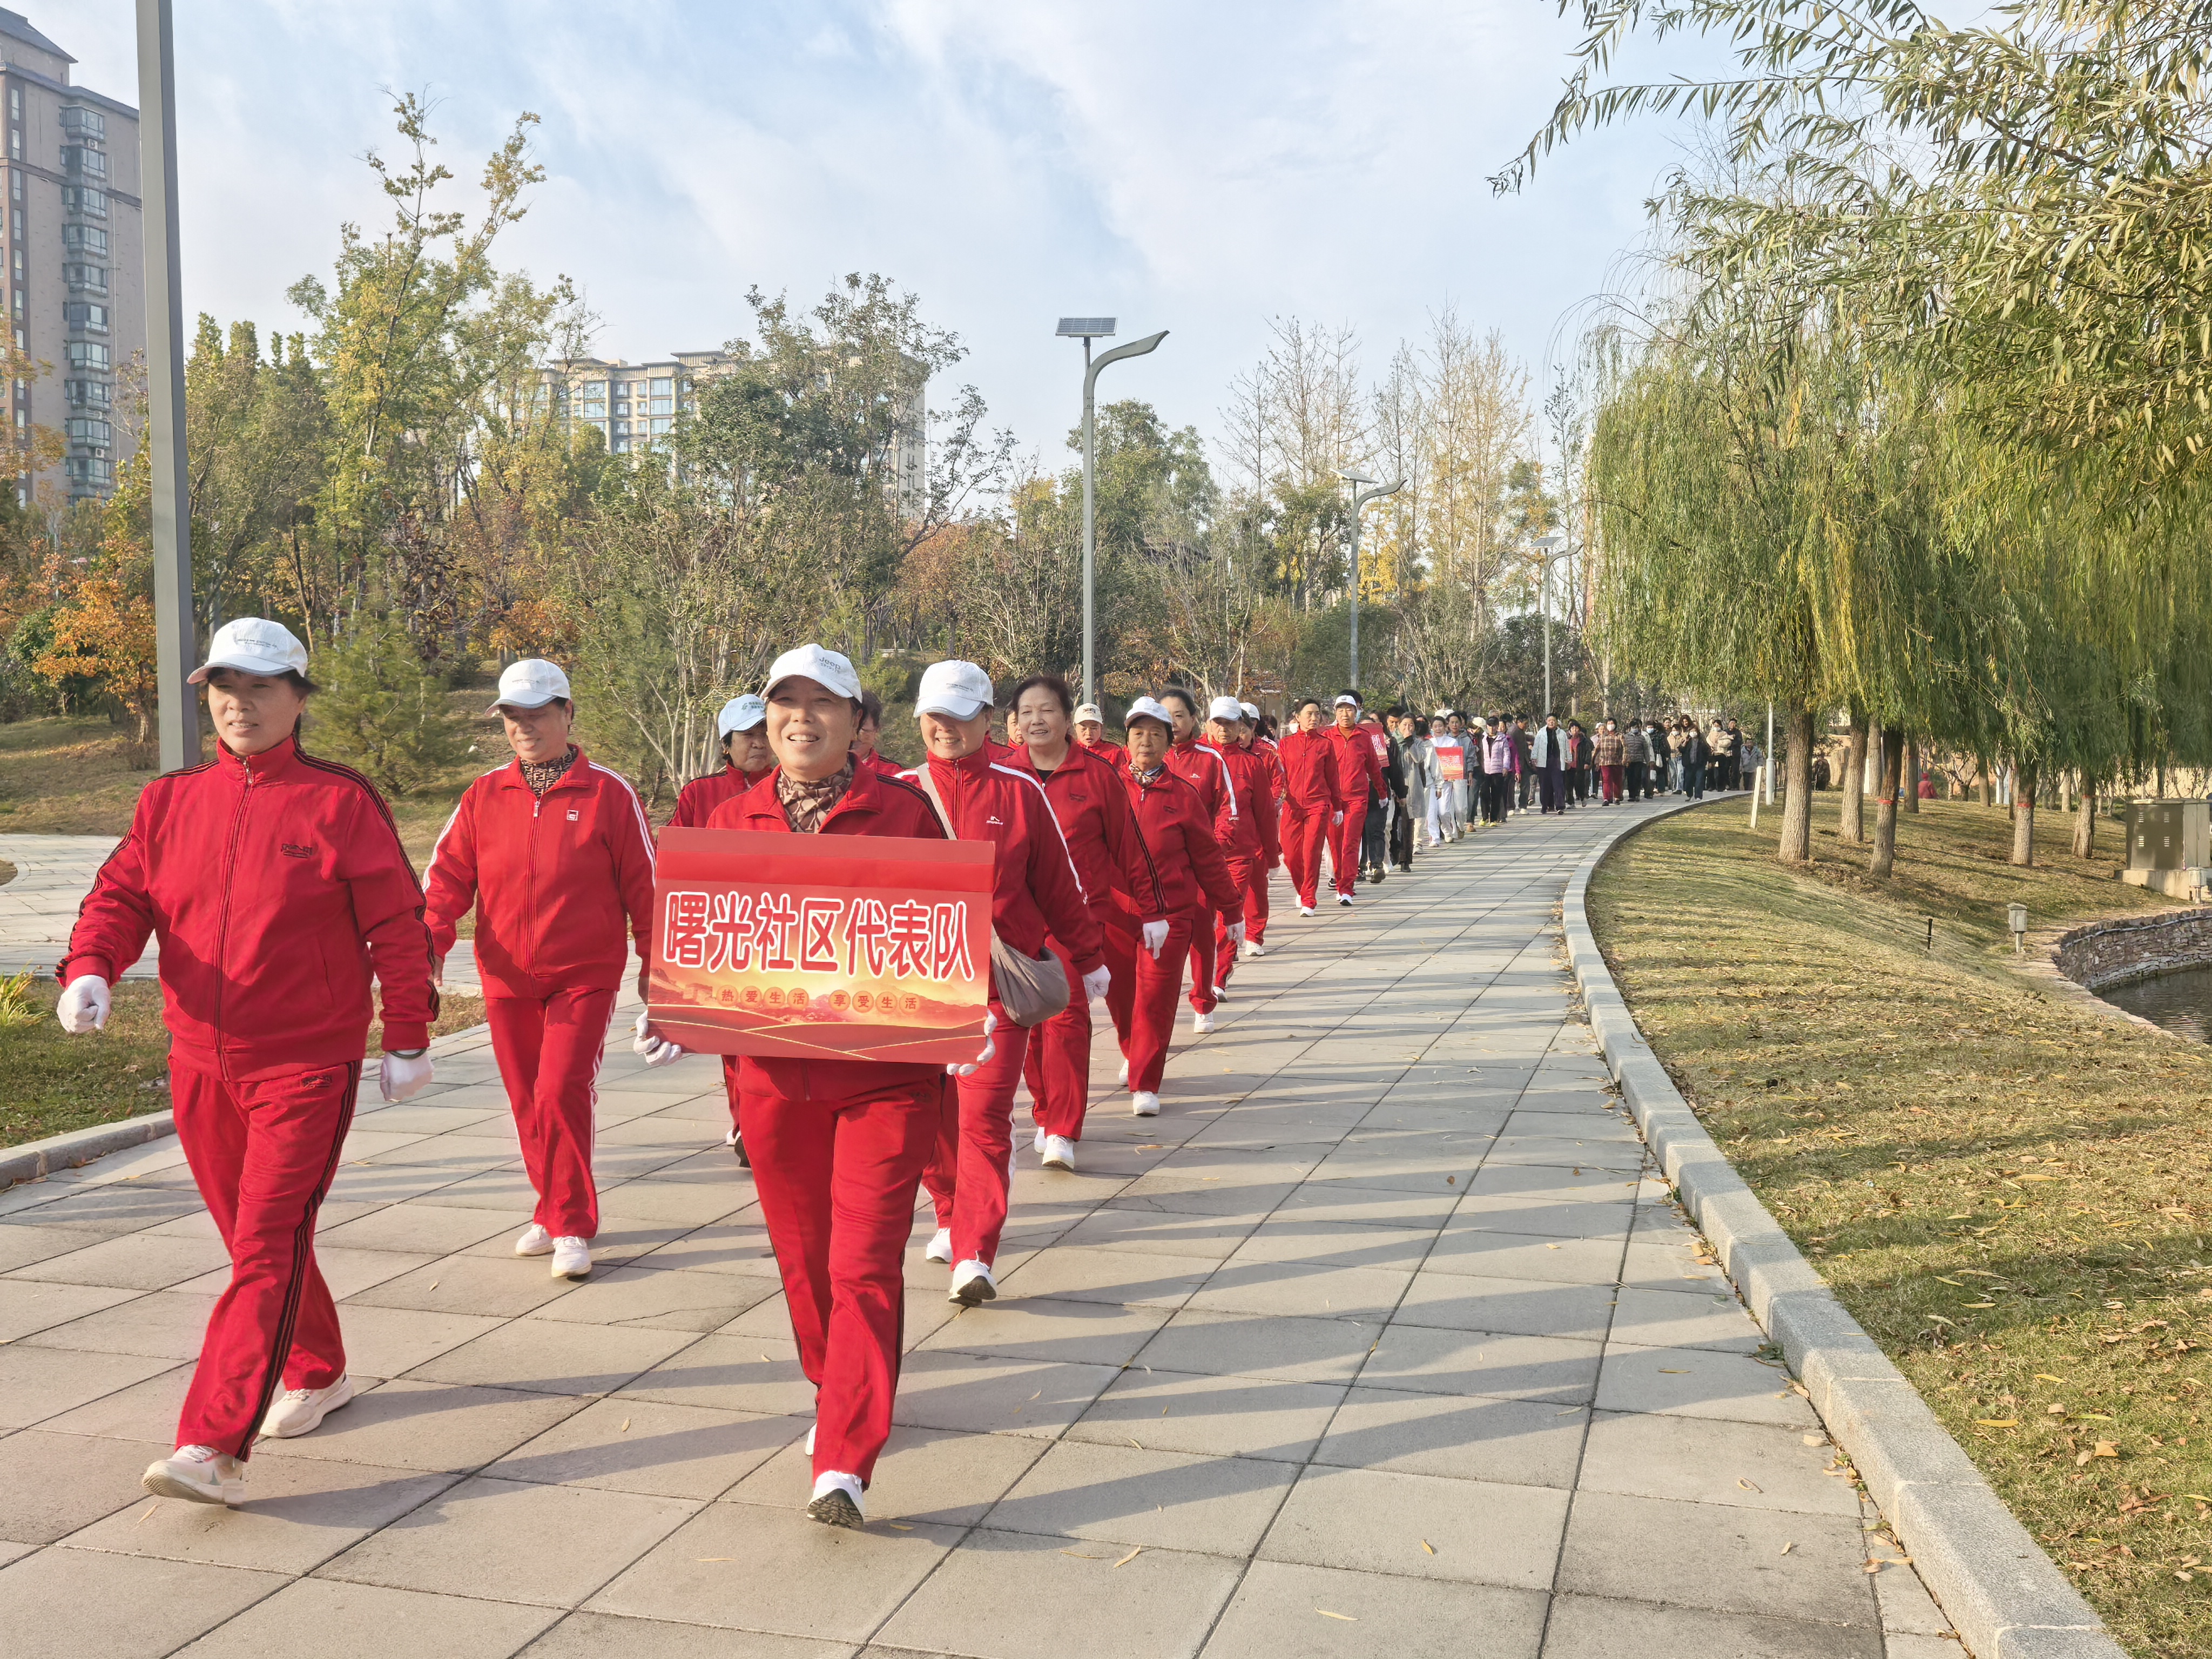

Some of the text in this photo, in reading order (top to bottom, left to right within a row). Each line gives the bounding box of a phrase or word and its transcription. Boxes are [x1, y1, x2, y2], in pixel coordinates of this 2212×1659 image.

[663, 891, 975, 982] 曙光社区代表队
[721, 989, 918, 1010] 热爱生活 享受生活
